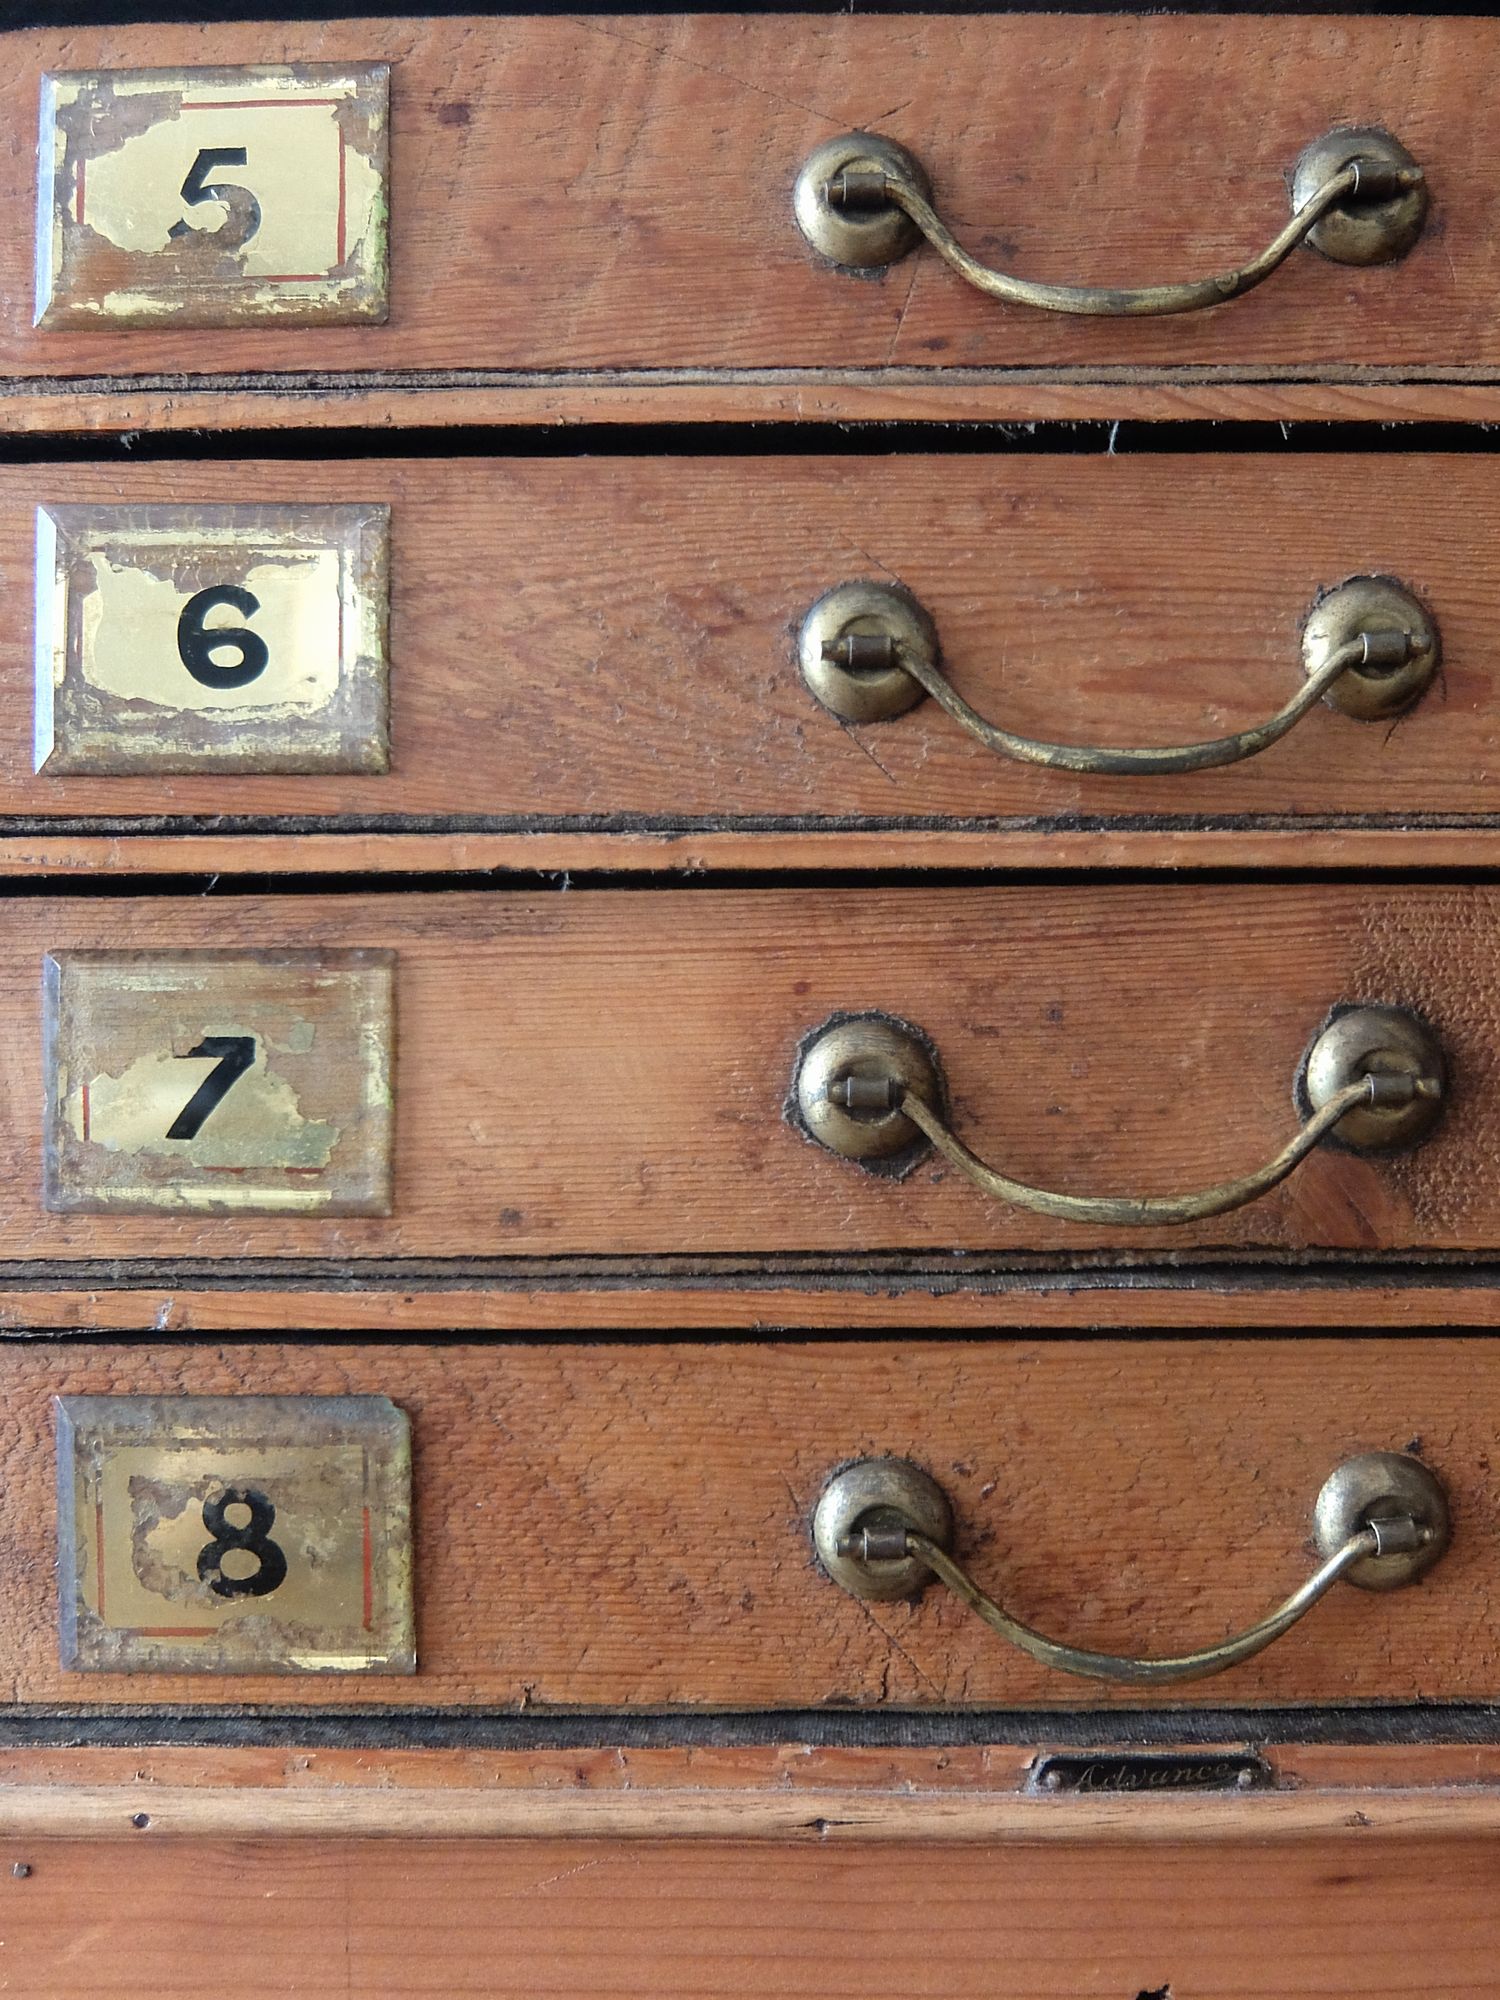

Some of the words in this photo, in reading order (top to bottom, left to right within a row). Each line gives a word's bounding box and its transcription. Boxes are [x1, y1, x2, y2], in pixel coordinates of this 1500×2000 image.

[167, 147, 262, 250] 5
[177, 584, 269, 690] 6
[165, 1036, 256, 1140] 7
[196, 1488, 287, 1598] 8
[1074, 1762, 1233, 1789] Advance
